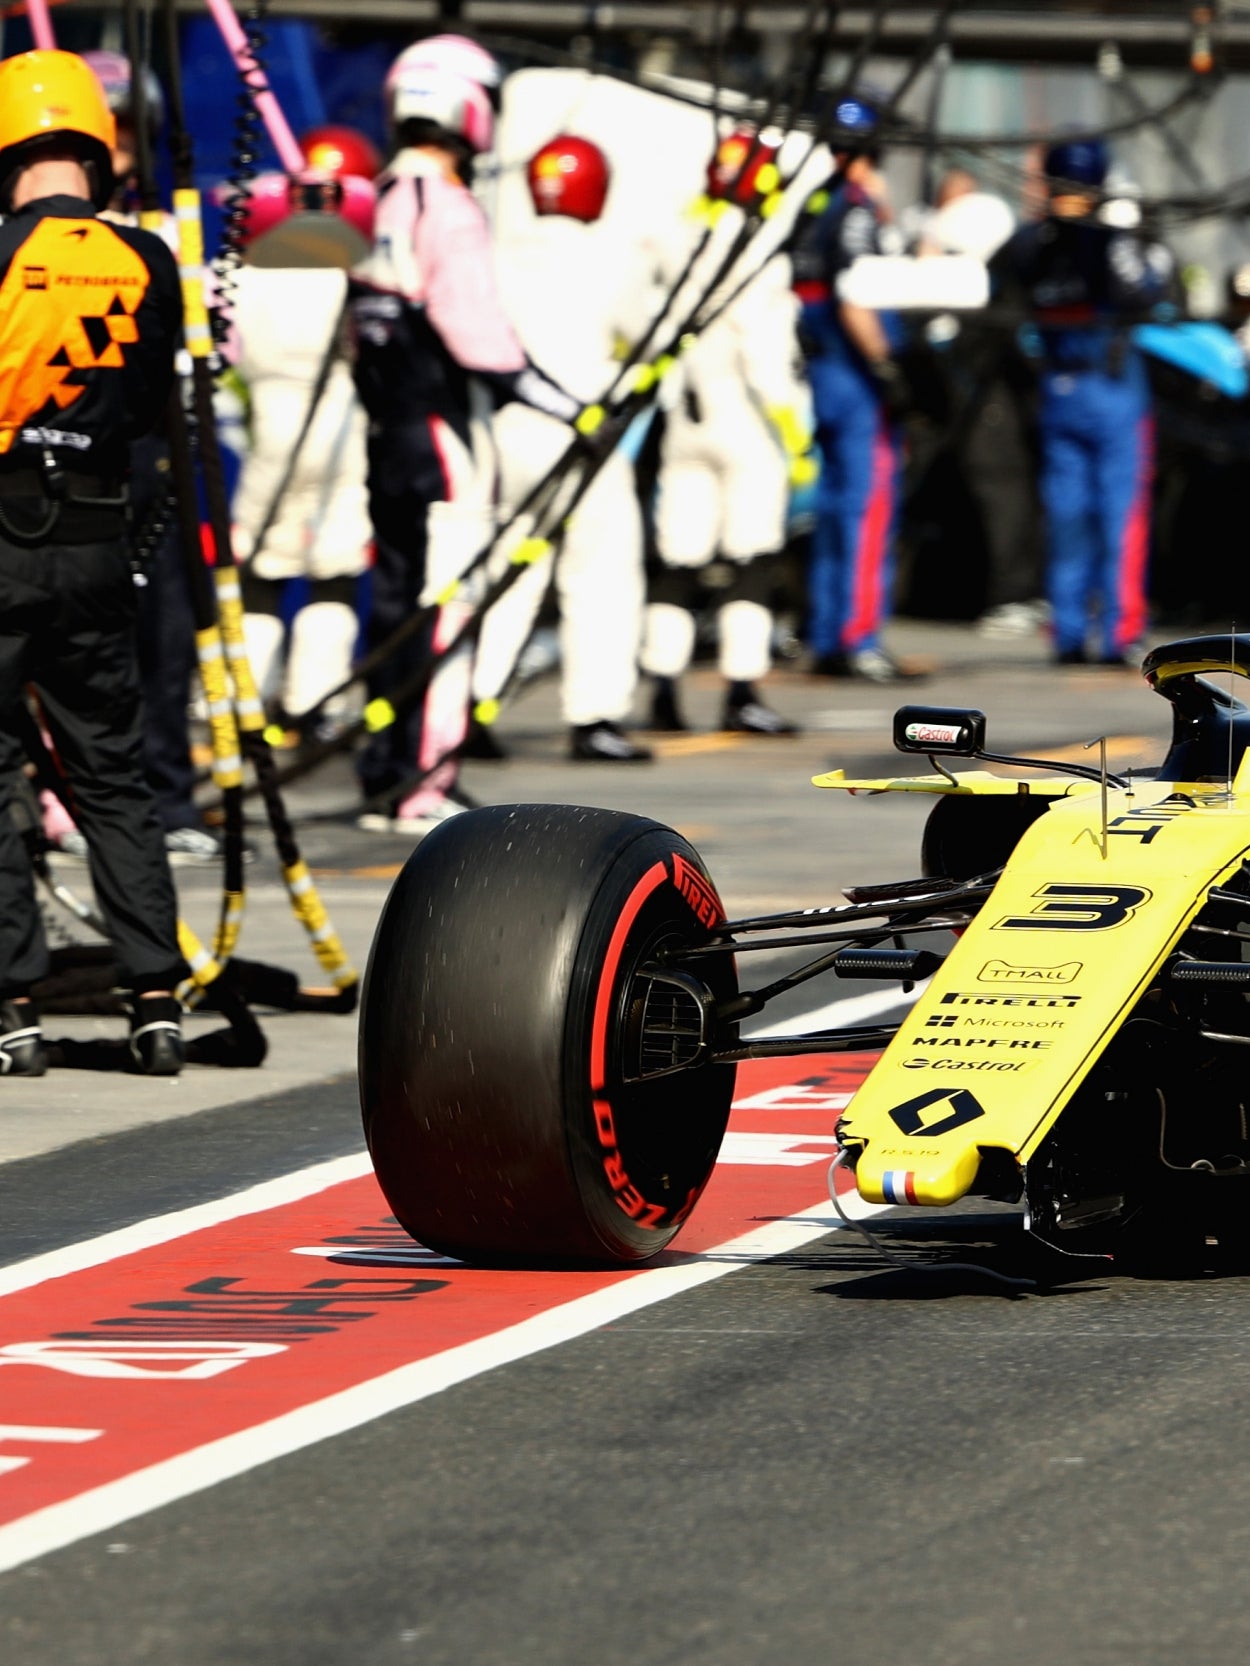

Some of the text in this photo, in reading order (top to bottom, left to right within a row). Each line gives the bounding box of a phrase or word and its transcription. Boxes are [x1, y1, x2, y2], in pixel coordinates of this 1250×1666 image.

[918, 726, 955, 742] Castrol
[990, 882, 1153, 932] 3
[990, 968, 1068, 981] TMALL
[939, 993, 1082, 1008] PIRELLI
[964, 1018, 1066, 1029] Microsoft
[912, 1037, 1054, 1050] MAPFRE
[931, 1059, 1027, 1072] Castrol
